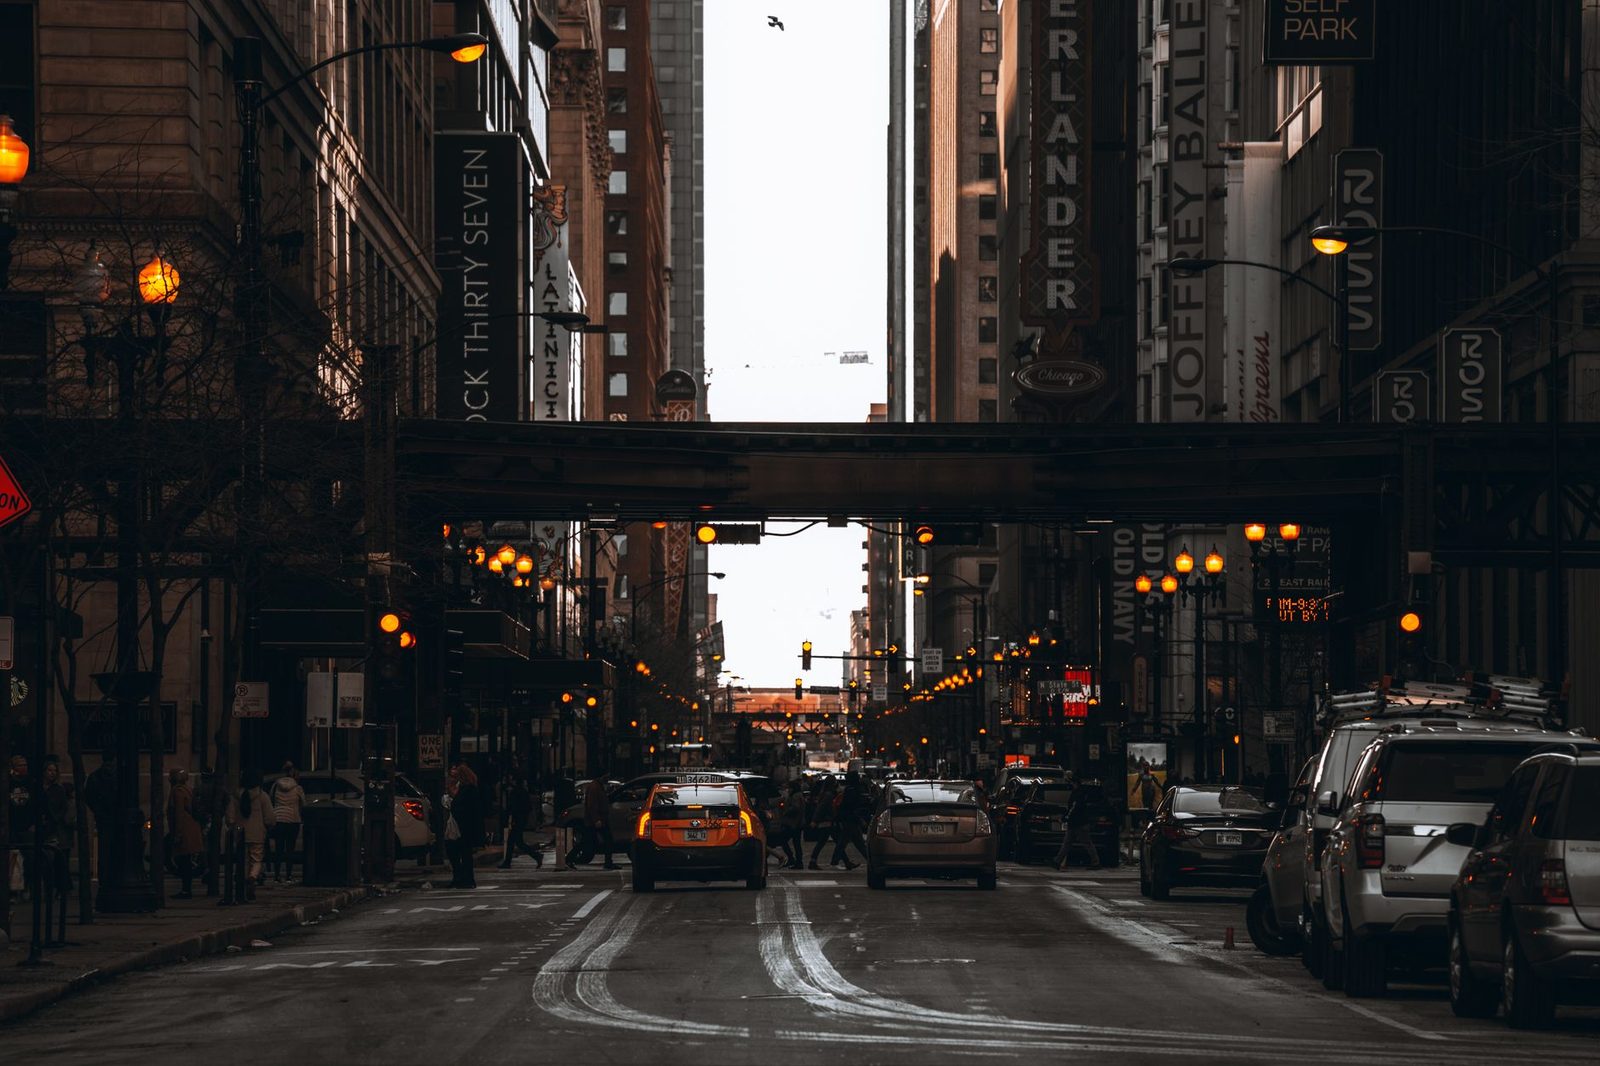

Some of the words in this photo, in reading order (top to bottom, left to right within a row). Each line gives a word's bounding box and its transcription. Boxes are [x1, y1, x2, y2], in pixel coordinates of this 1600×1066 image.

[1283, 17, 1358, 41] PARK
[463, 149, 489, 246] SEVEN
[463, 256, 489, 359] THIRTY
[1173, 181, 1204, 416] JOFFREY
[1038, 367, 1085, 386] Chicago
[1458, 334, 1486, 424] ROS
[1391, 376, 1416, 423] RO
[0, 481, 20, 496] ON
[904, 525, 915, 577] ARK
[1113, 528, 1136, 576] OLD
[1260, 537, 1308, 553] SEF
[1280, 578, 1305, 587] EAST
[1113, 581, 1136, 645] NAVY
[1279, 610, 1296, 623] UT
[420, 736, 441, 745] ONE
[420, 745, 442, 756] WAY
[687, 775, 710, 783] 3662
